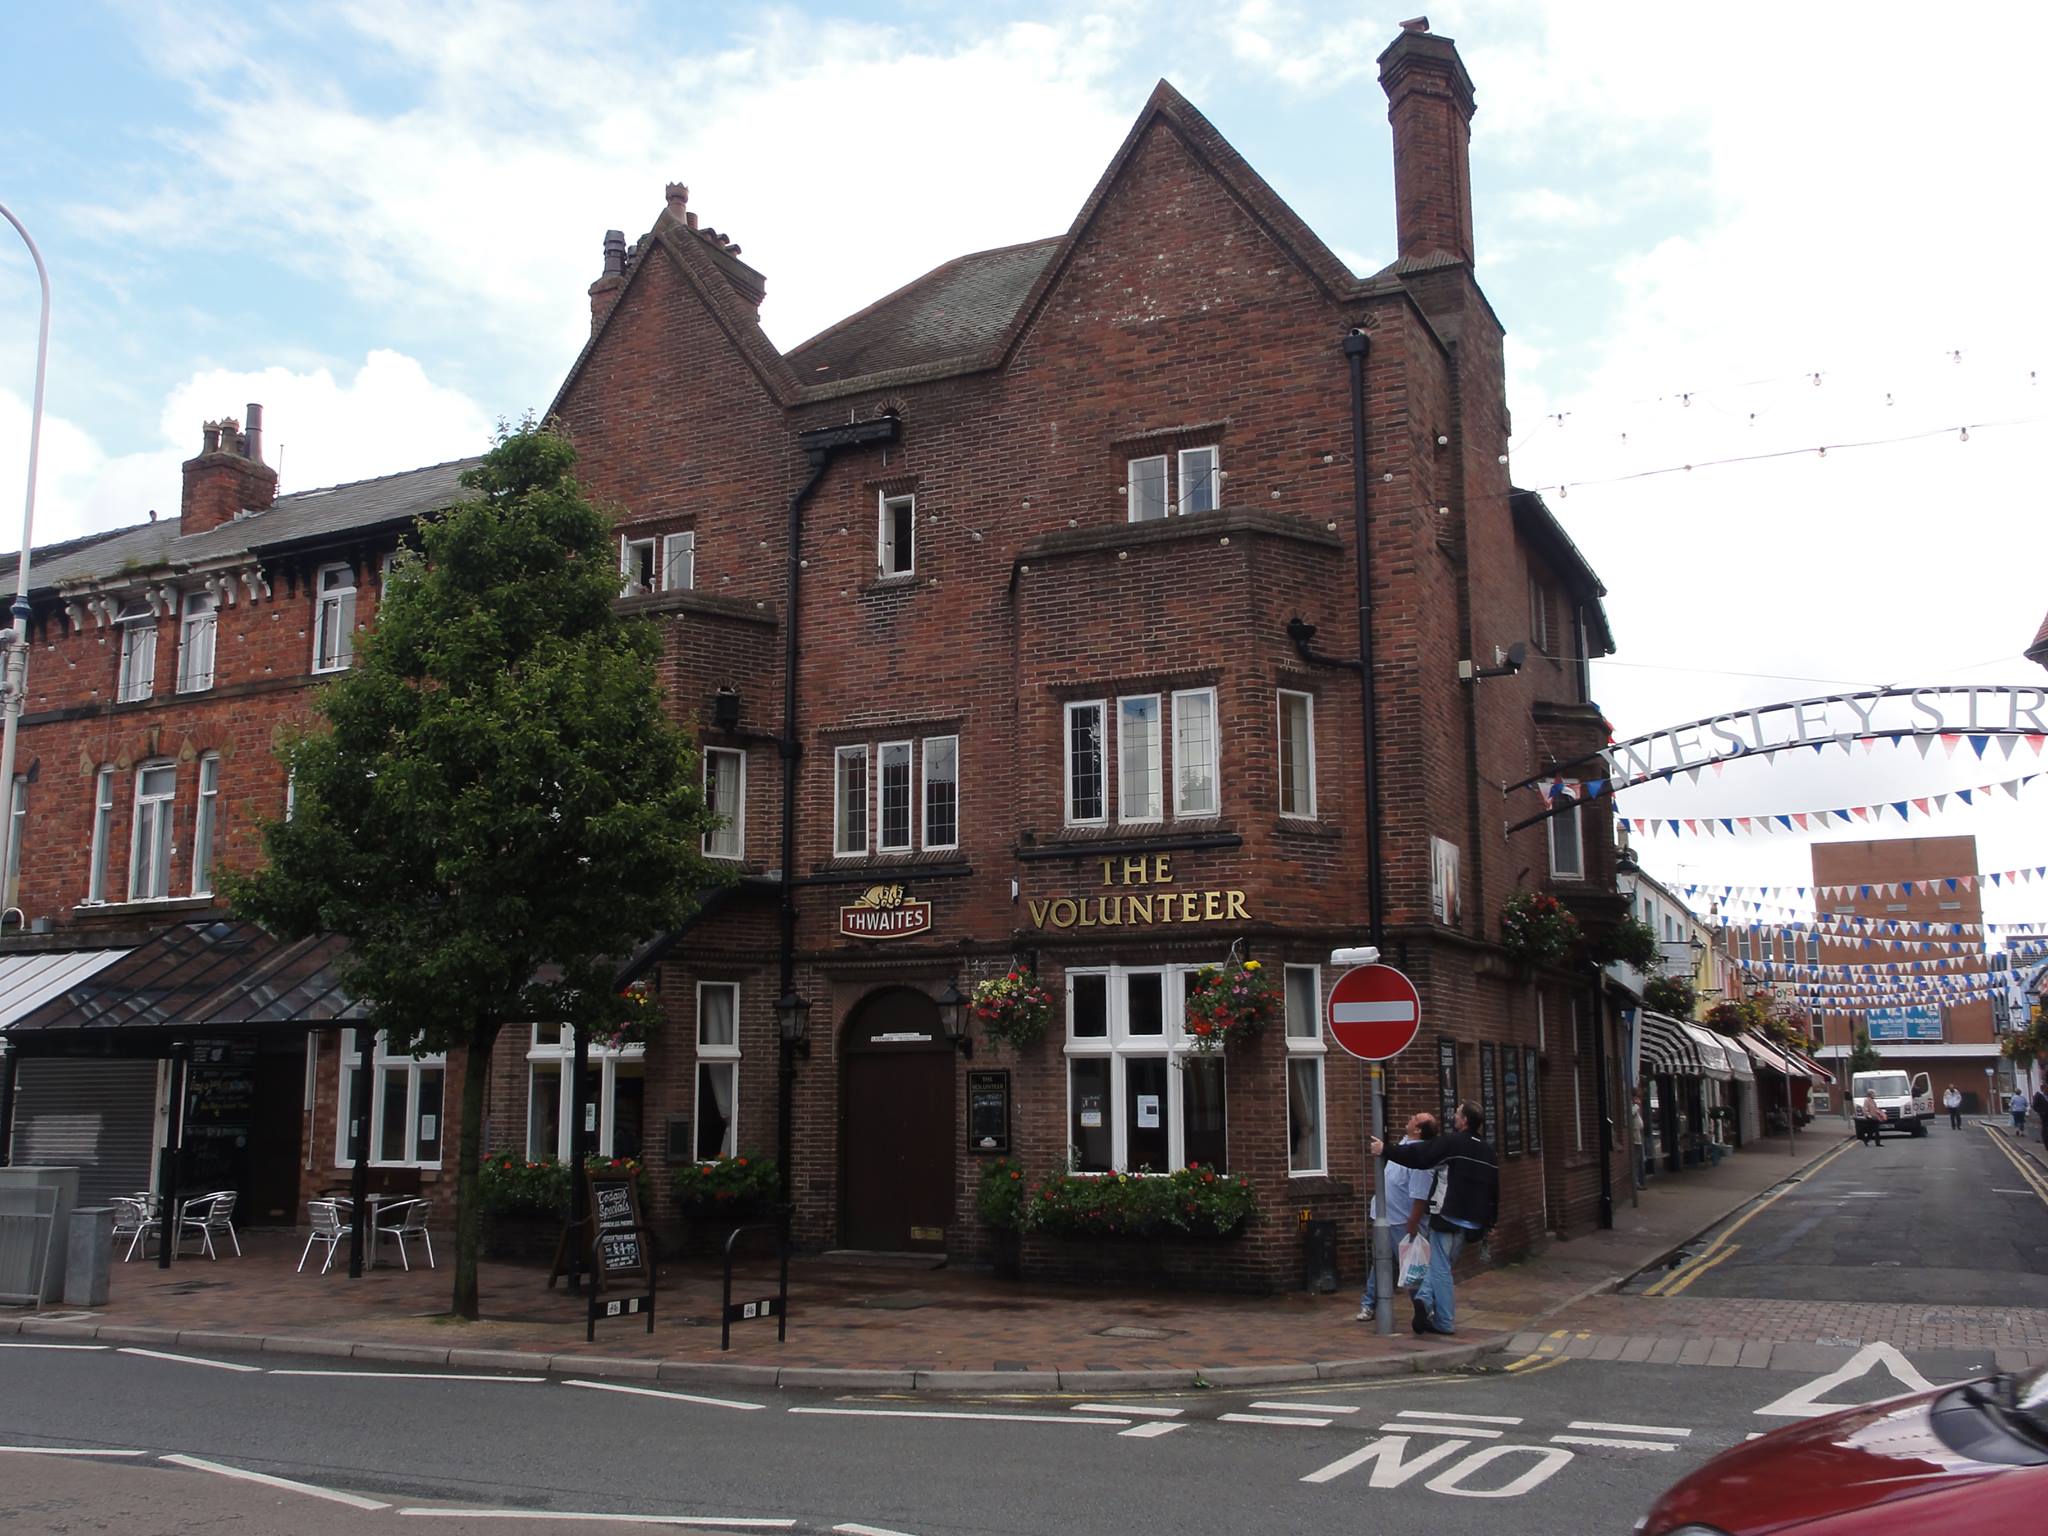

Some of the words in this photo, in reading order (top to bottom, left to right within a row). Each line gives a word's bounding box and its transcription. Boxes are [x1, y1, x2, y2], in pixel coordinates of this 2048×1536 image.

[1596, 690, 1888, 787] WESLEY
[1100, 854, 1174, 886] THE
[846, 909, 924, 931] THWAITES
[1028, 889, 1252, 929] VOLUNTEER
[1299, 1434, 1575, 1498] NO
